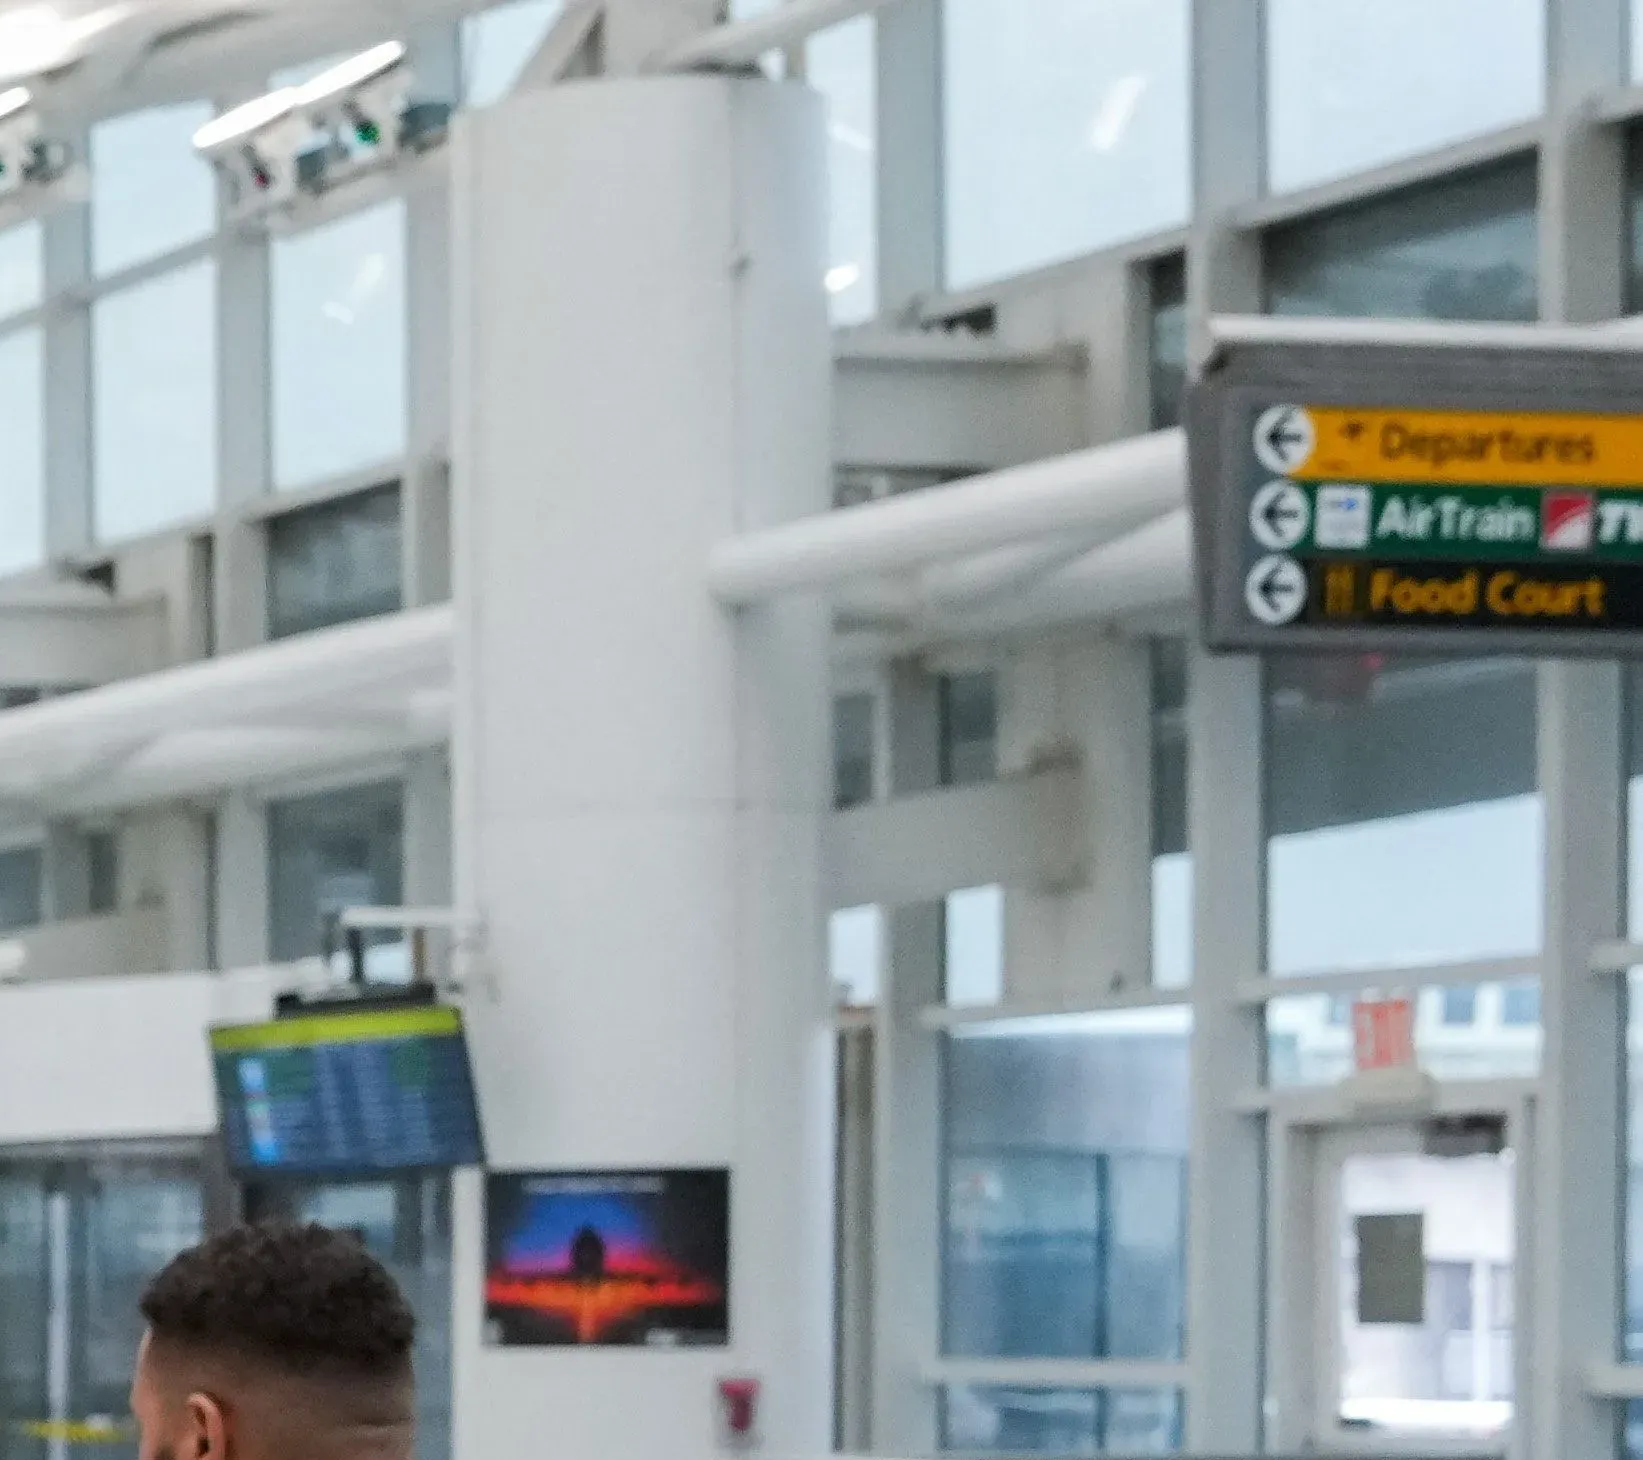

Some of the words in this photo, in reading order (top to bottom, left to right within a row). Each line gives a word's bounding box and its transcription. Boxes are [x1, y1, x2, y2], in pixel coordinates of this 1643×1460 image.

[1379, 421, 1598, 468] Departures
[1376, 494, 1537, 542] AirTrain
[1370, 567, 1482, 616] Food
[1486, 570, 1606, 618] Court
